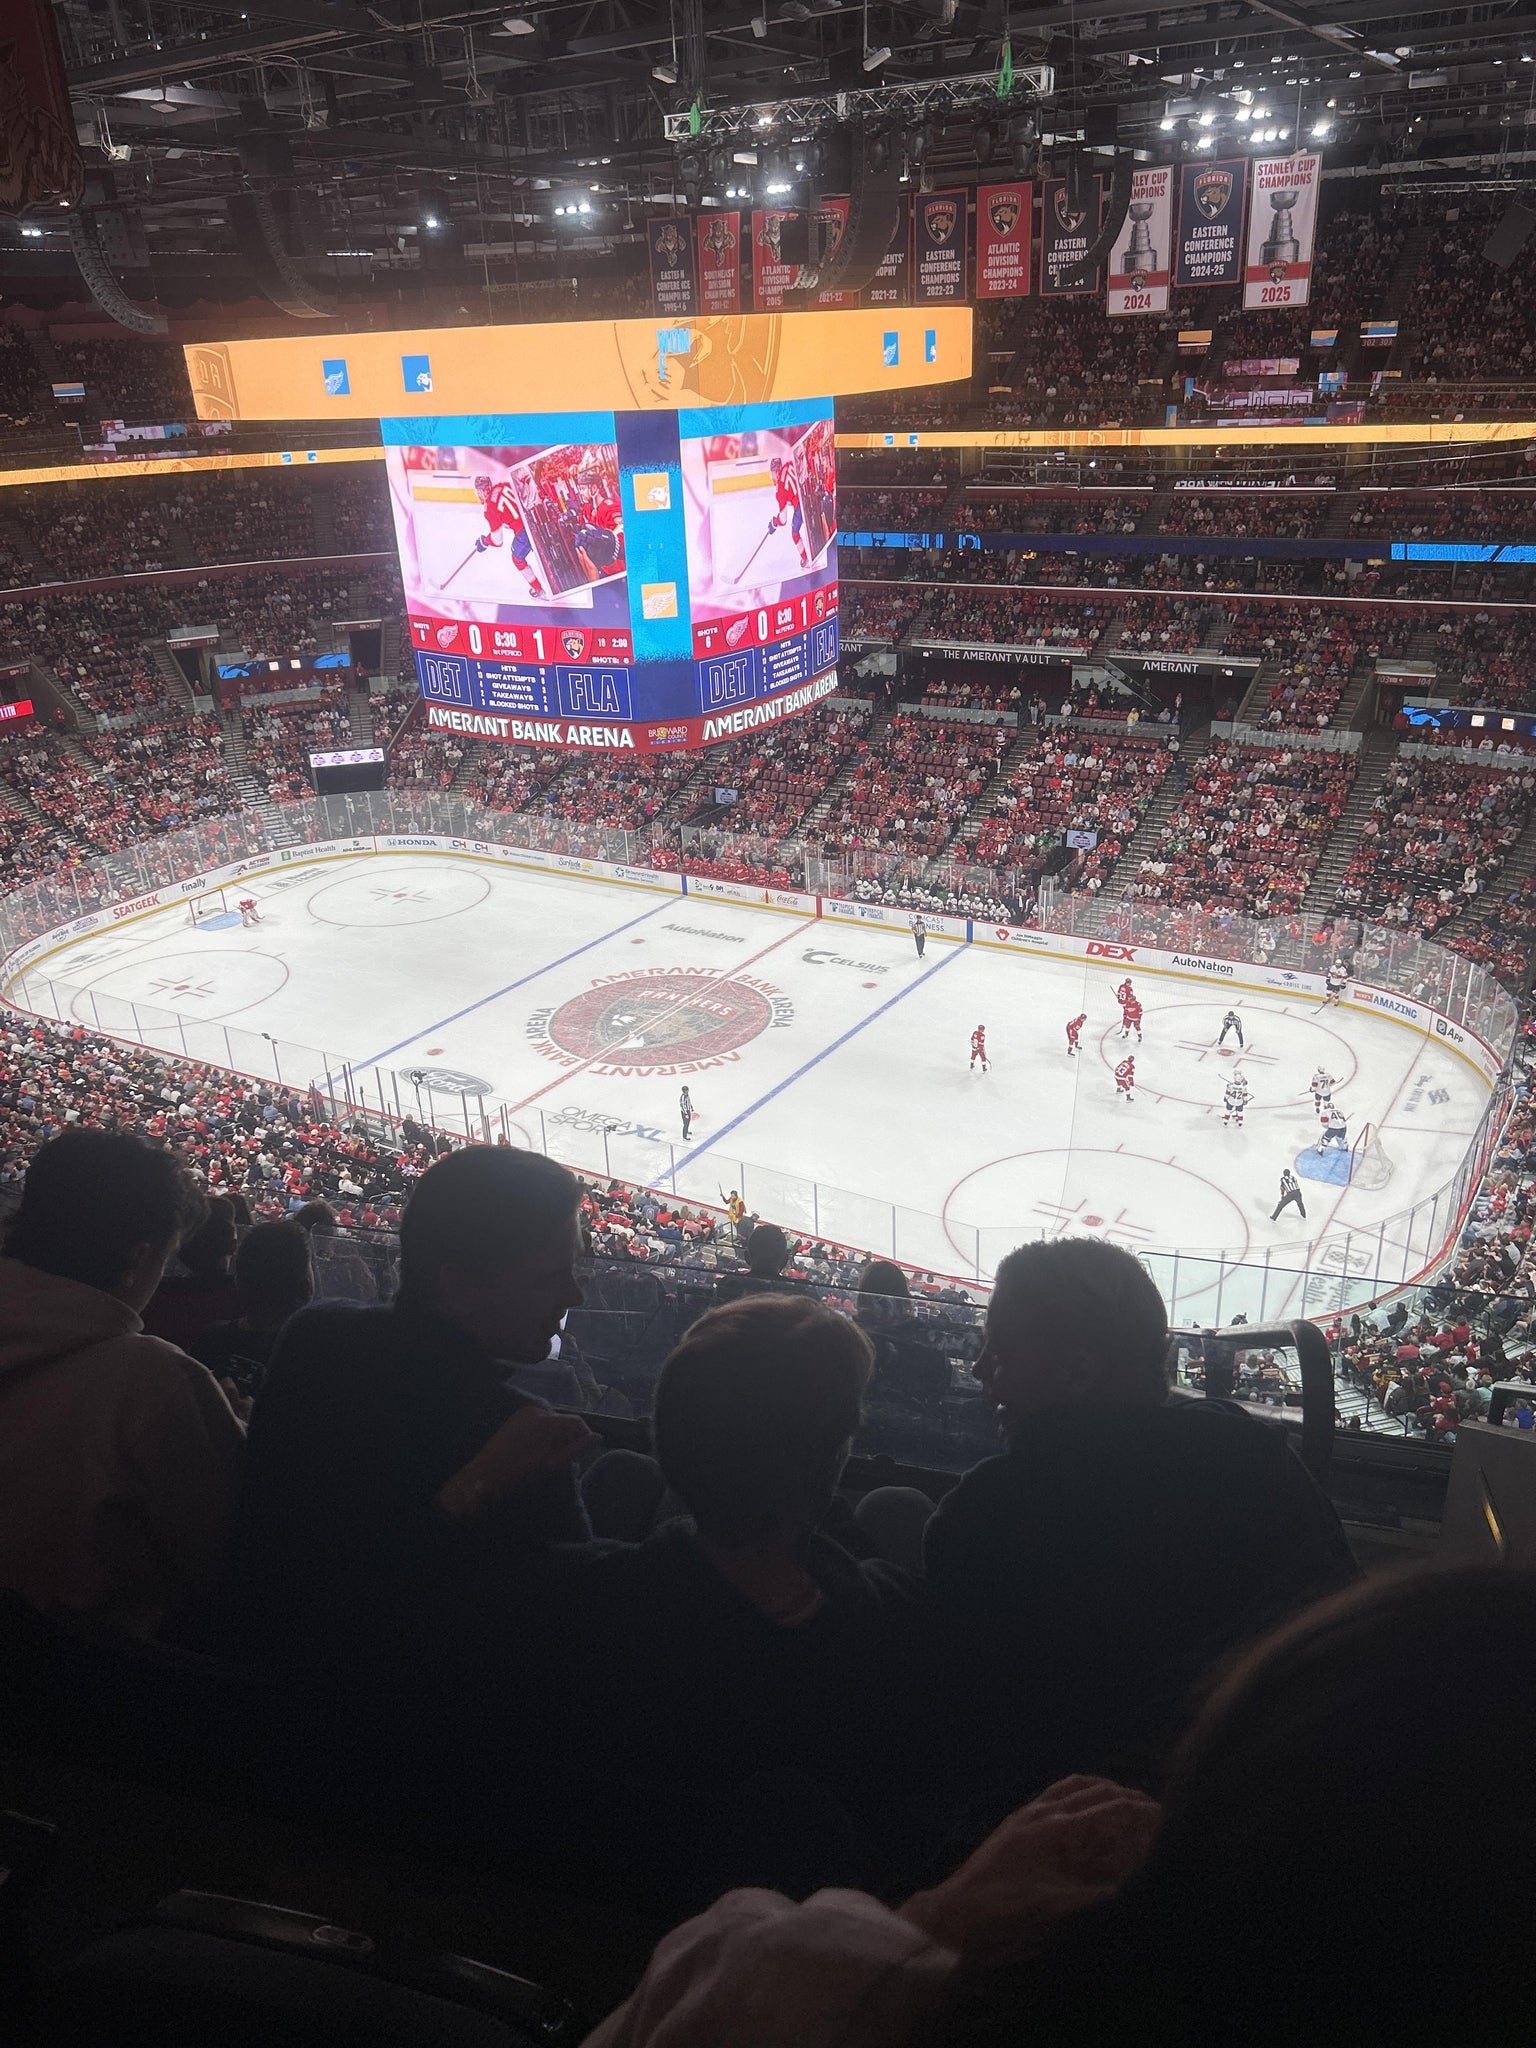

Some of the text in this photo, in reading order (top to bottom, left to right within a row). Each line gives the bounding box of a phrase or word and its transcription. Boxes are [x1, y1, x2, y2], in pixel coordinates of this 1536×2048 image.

[1257, 159, 1316, 176] STANLEY CUP
[1133, 171, 1168, 187] NLEY CUP
[1259, 173, 1312, 189] CHAMPIONS
[1130, 185, 1165, 200] AMPIONS
[1192, 225, 1228, 239] EASTERN
[987, 242, 1020, 255] ATLANTIC
[1054, 238, 1087, 250] EASTERN
[1184, 237, 1234, 252] CONFERENCE
[926, 249, 955, 261] EASTERN
[988, 255, 1019, 266] DIVISION
[1185, 251, 1232, 265] CHAMPIONS
[761, 265, 791, 275] ATLANTIC
[875, 266, 896, 276] ROPHY
[920, 260, 961, 273] CONFERENCE
[983, 266, 1023, 279] CHAMPIONS
[1190, 264, 1225, 277] 2024-25
[921, 273, 959, 285] CHAMPIONS
[988, 279, 1017, 291] 2023-24
[871, 290, 897, 300] 2021-22
[926, 285, 954, 296] 2022-23
[1261, 286, 1291, 303] 2025
[1123, 294, 1151, 310] 2024
[777, 607, 792, 626] 6:30
[800, 597, 807, 627] 1
[697, 627, 718, 637] SHOTS
[757, 610, 768, 640] 0
[468, 624, 483, 655] 0
[494, 631, 517, 648] 6:30
[532, 629, 545, 660] 1
[816, 625, 836, 667] FLA
[839, 643, 863, 653] RANT
[943, 649, 1050, 665] THE AMERANT VAULT
[501, 665, 517, 673] HITS
[1142, 660, 1199, 673] AMERANT
[425, 659, 462, 698] DET
[709, 658, 748, 704] DET
[492, 682, 532, 692] GIVEAWAYS
[568, 673, 620, 713] FLA
[492, 691, 534, 701] TAKEAWAYS
[702, 670, 839, 741] AMERANT BANK ARENA
[428, 706, 636, 749] AMERANT BANK ARENA
[397, 839, 438, 847] HONDA
[181, 878, 207, 893] finally
[113, 893, 161, 920] SEATGEEK
[659, 923, 747, 944] AutoNation
[908, 920, 945, 932] BNESS
[1086, 942, 1138, 962] DEX
[829, 956, 890, 974] CELSIUS
[1172, 955, 1234, 974] AutoNation
[590, 967, 795, 1028] AMERANT BANK ARENA
[1373, 995, 1418, 1019] AMAZING
[526, 1007, 557, 1039] ARENA
[529, 1040, 582, 1067] BANK
[588, 1051, 741, 1077] AMERANT
[1230, 1090, 1243, 1100] 42
[548, 1114, 612, 1135] SPOR
[561, 1106, 632, 1130] OMEGA
